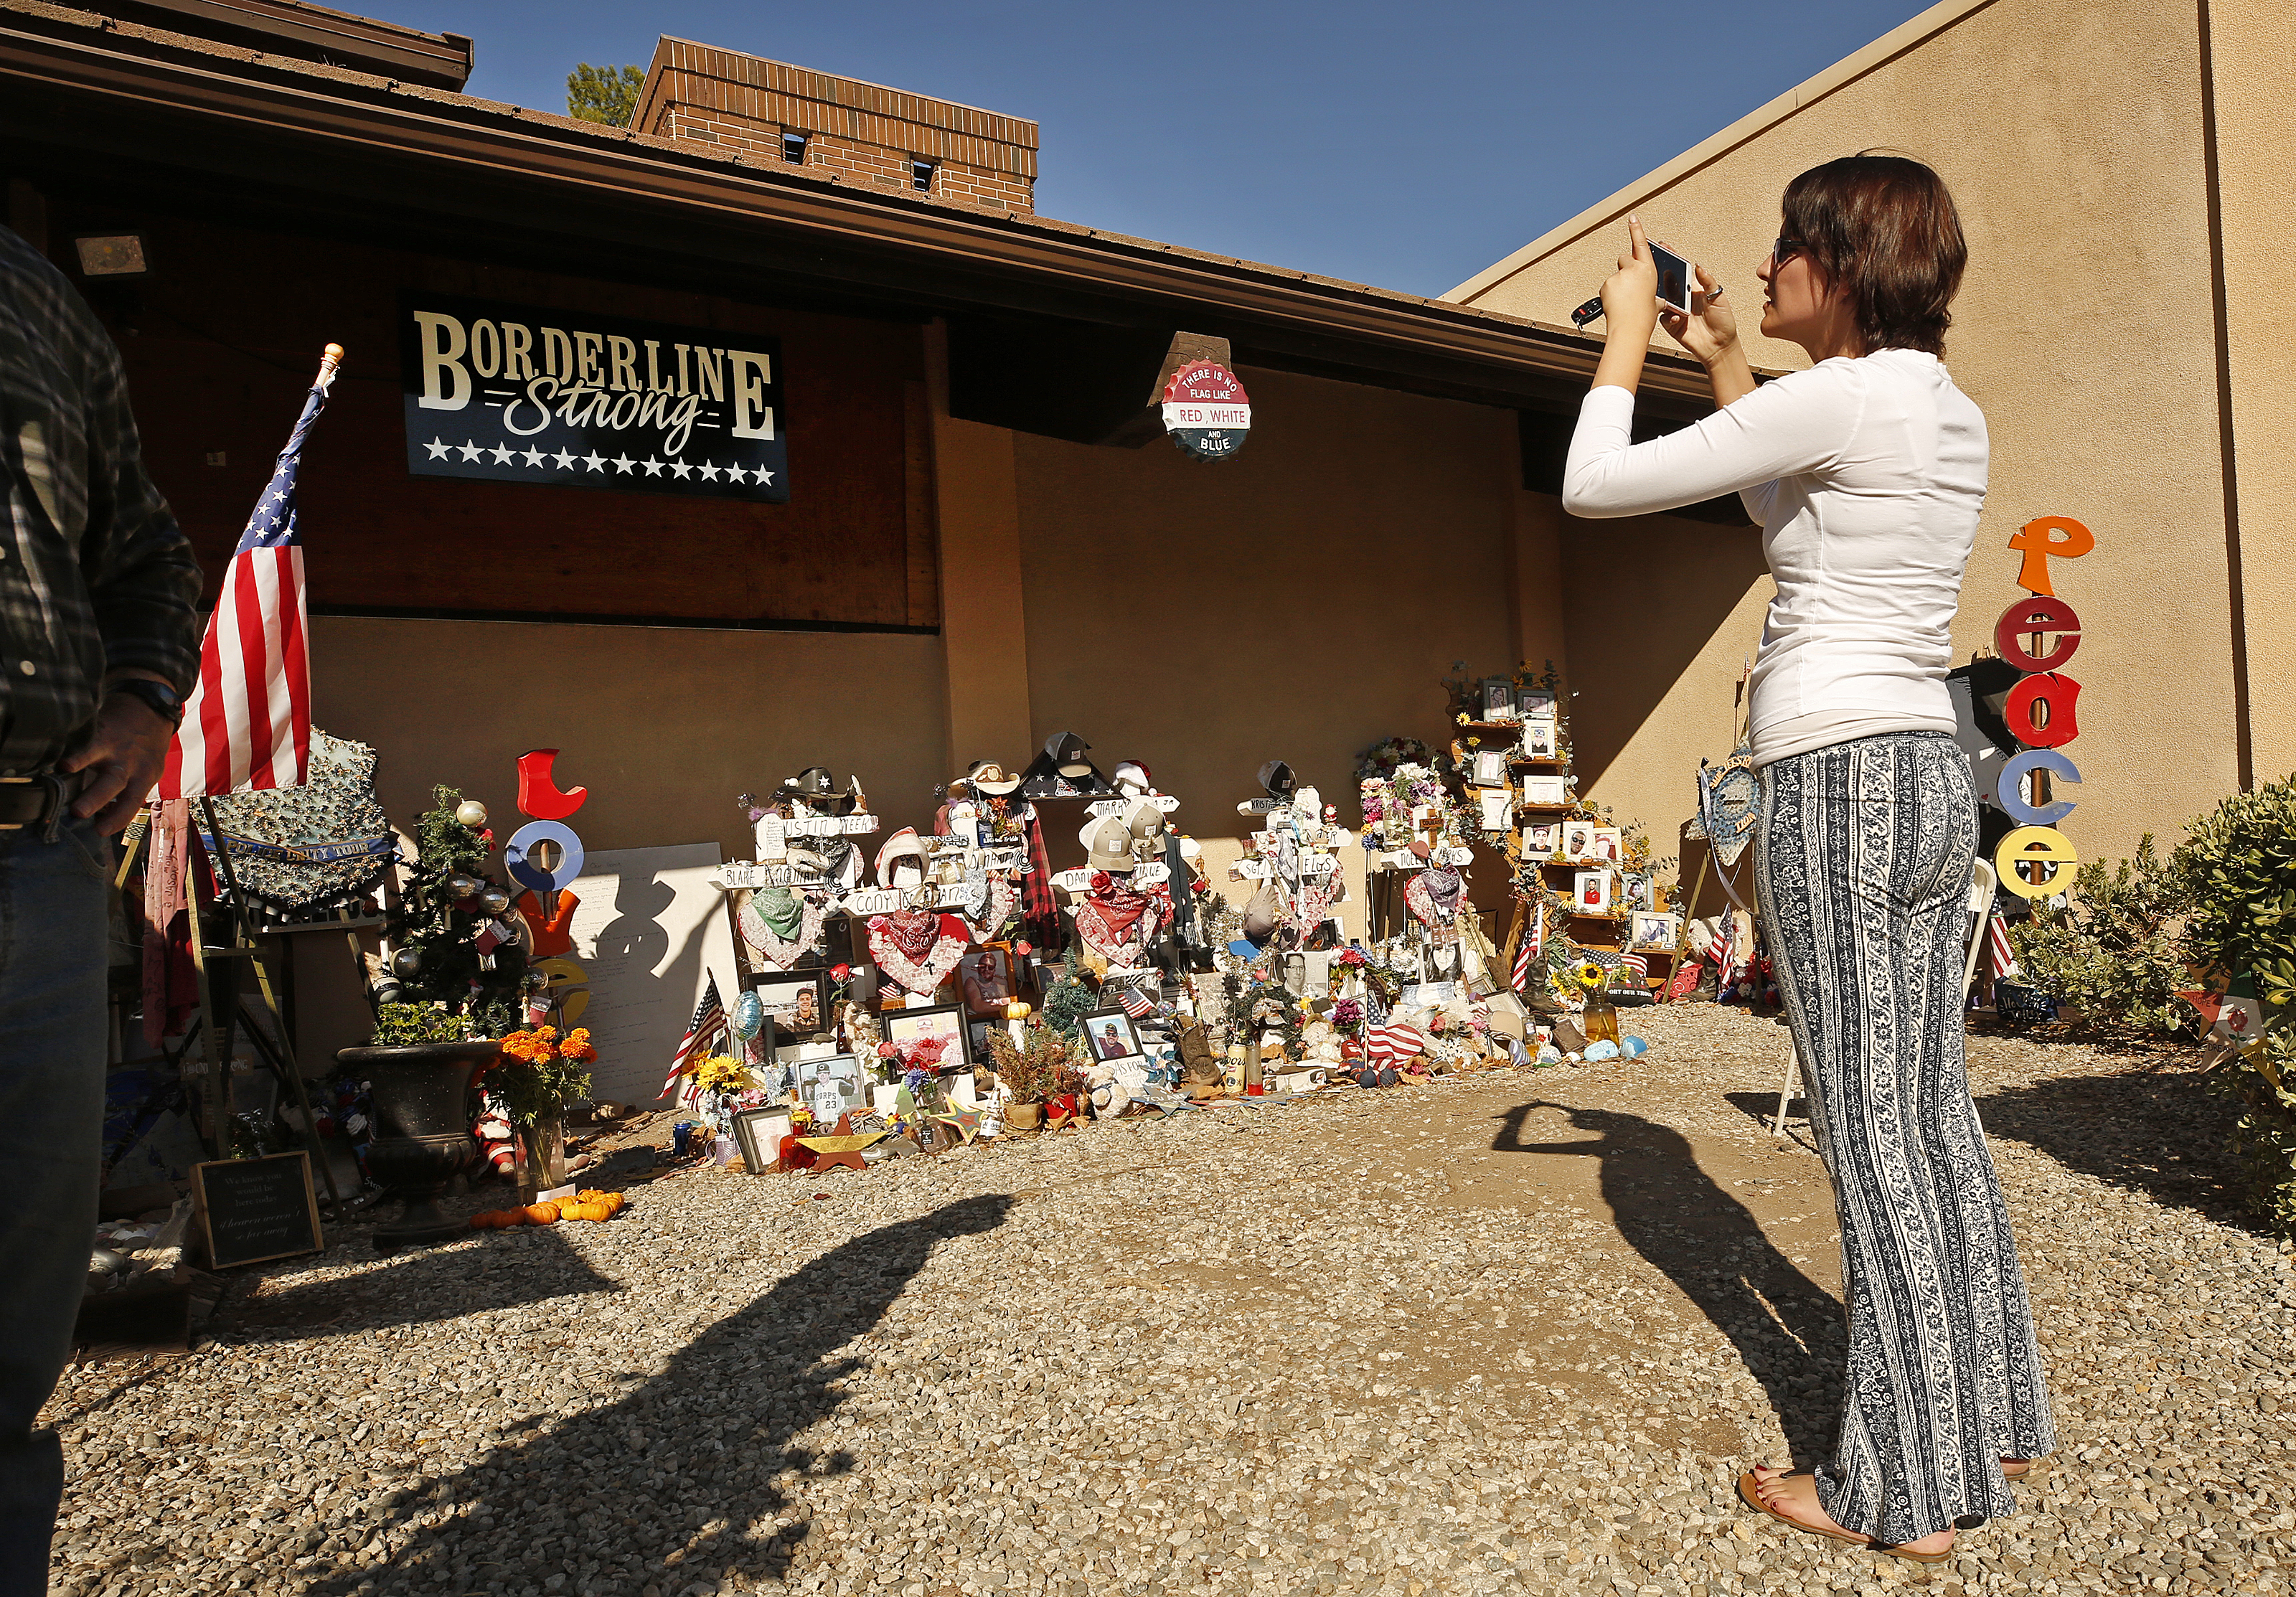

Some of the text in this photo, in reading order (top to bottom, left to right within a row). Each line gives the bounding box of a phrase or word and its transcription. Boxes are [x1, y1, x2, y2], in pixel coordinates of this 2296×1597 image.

[413, 310, 774, 440] BORDERLINE
[1182, 369, 1238, 392] THERE IS NO
[1190, 389, 1231, 400] FLAG LIKE
[504, 376, 702, 456] Strong
[1210, 410, 1246, 423] WHITE
[1200, 438, 1231, 451] BLUE
[785, 819, 827, 837] USTIN
[227, 839, 371, 862] POLICE UNITY TOUR
[164, 866, 179, 897] JASON
[727, 869, 755, 885] BLAKE
[857, 895, 892, 913] CODY
[2192, 996, 2211, 1007] HOPE
[2263, 1009, 2289, 1018] FAITH
[2208, 1042, 2234, 1055] DREAM
[2249, 1051, 2264, 1062] JOY
[1112, 1059, 1125, 1075] AS
[1142, 1093, 1187, 1103] YOU ARE
[825, 1101, 837, 1109] 23
[242, 1176, 263, 1184] know
[267, 1174, 282, 1182] you
[236, 1184, 262, 1195] would
[255, 1195, 278, 1205] today
[227, 1217, 260, 1228] heaven
[246, 1230, 261, 1240] far
[263, 1226, 288, 1238] away
